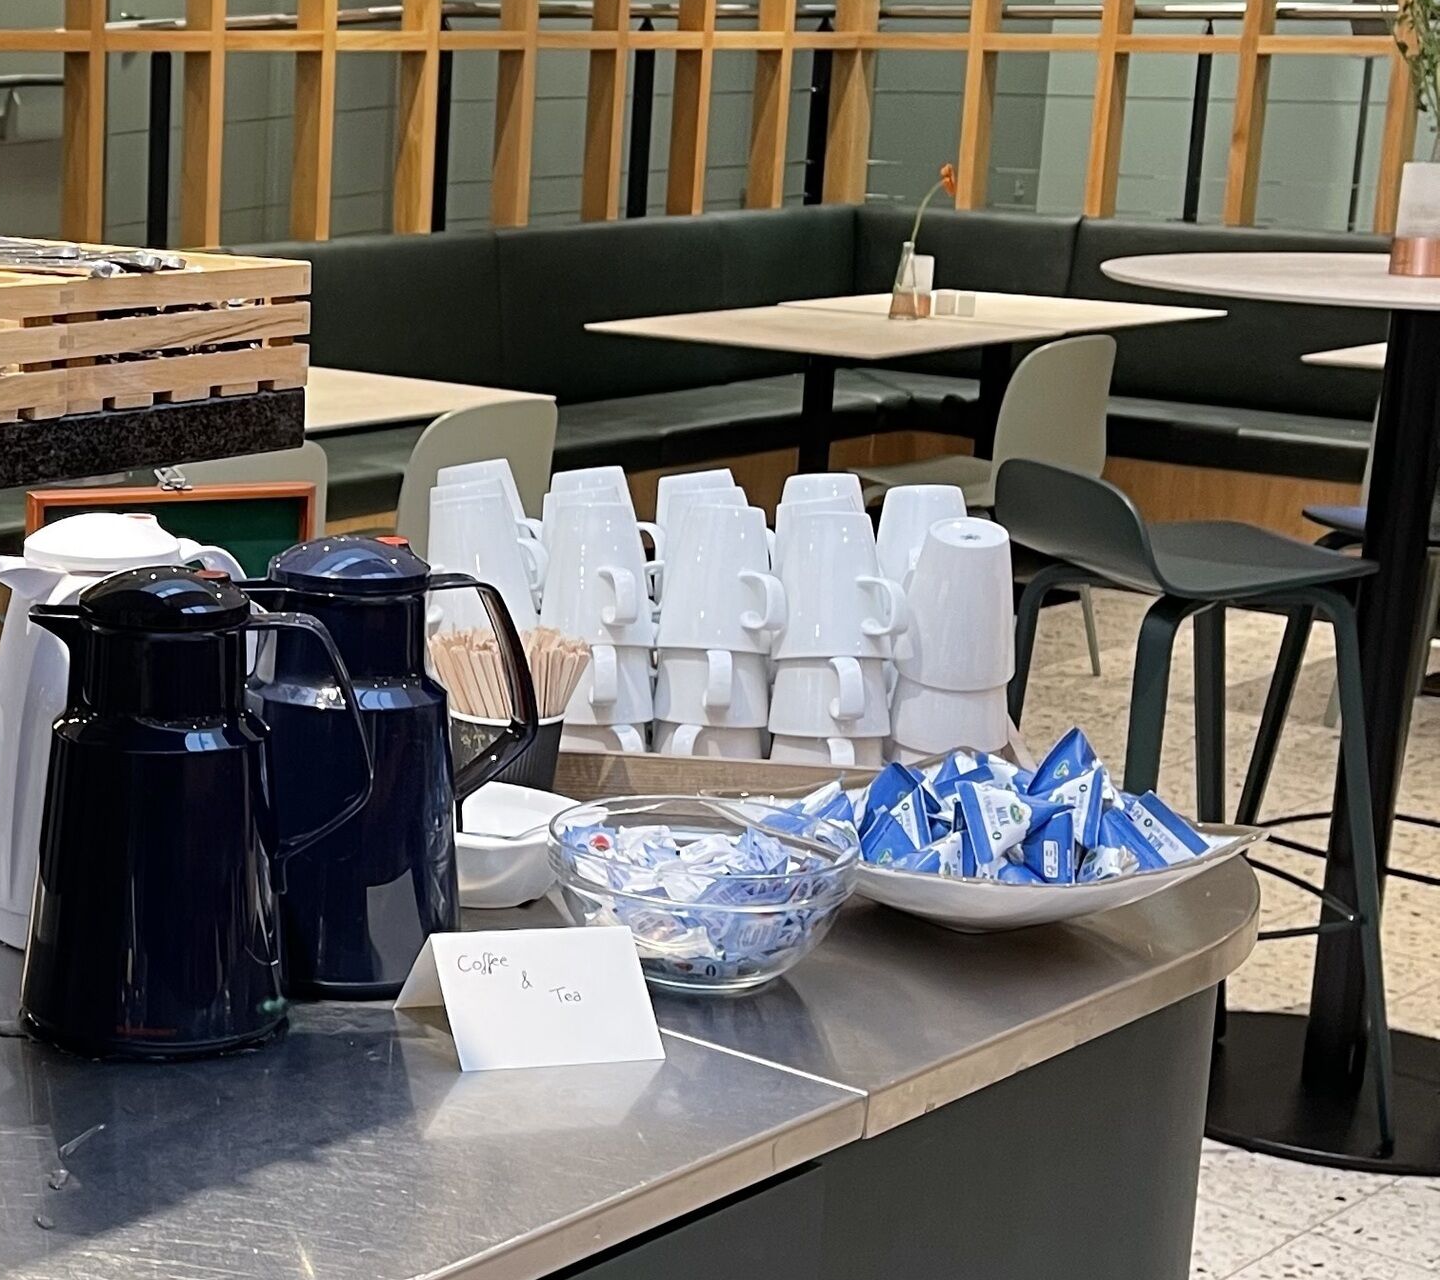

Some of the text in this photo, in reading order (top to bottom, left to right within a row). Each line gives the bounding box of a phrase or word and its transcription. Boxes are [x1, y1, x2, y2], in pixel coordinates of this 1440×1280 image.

[457, 951, 509, 975] Coffee
[521, 969, 534, 990] &
[548, 986, 582, 1003] Tea
